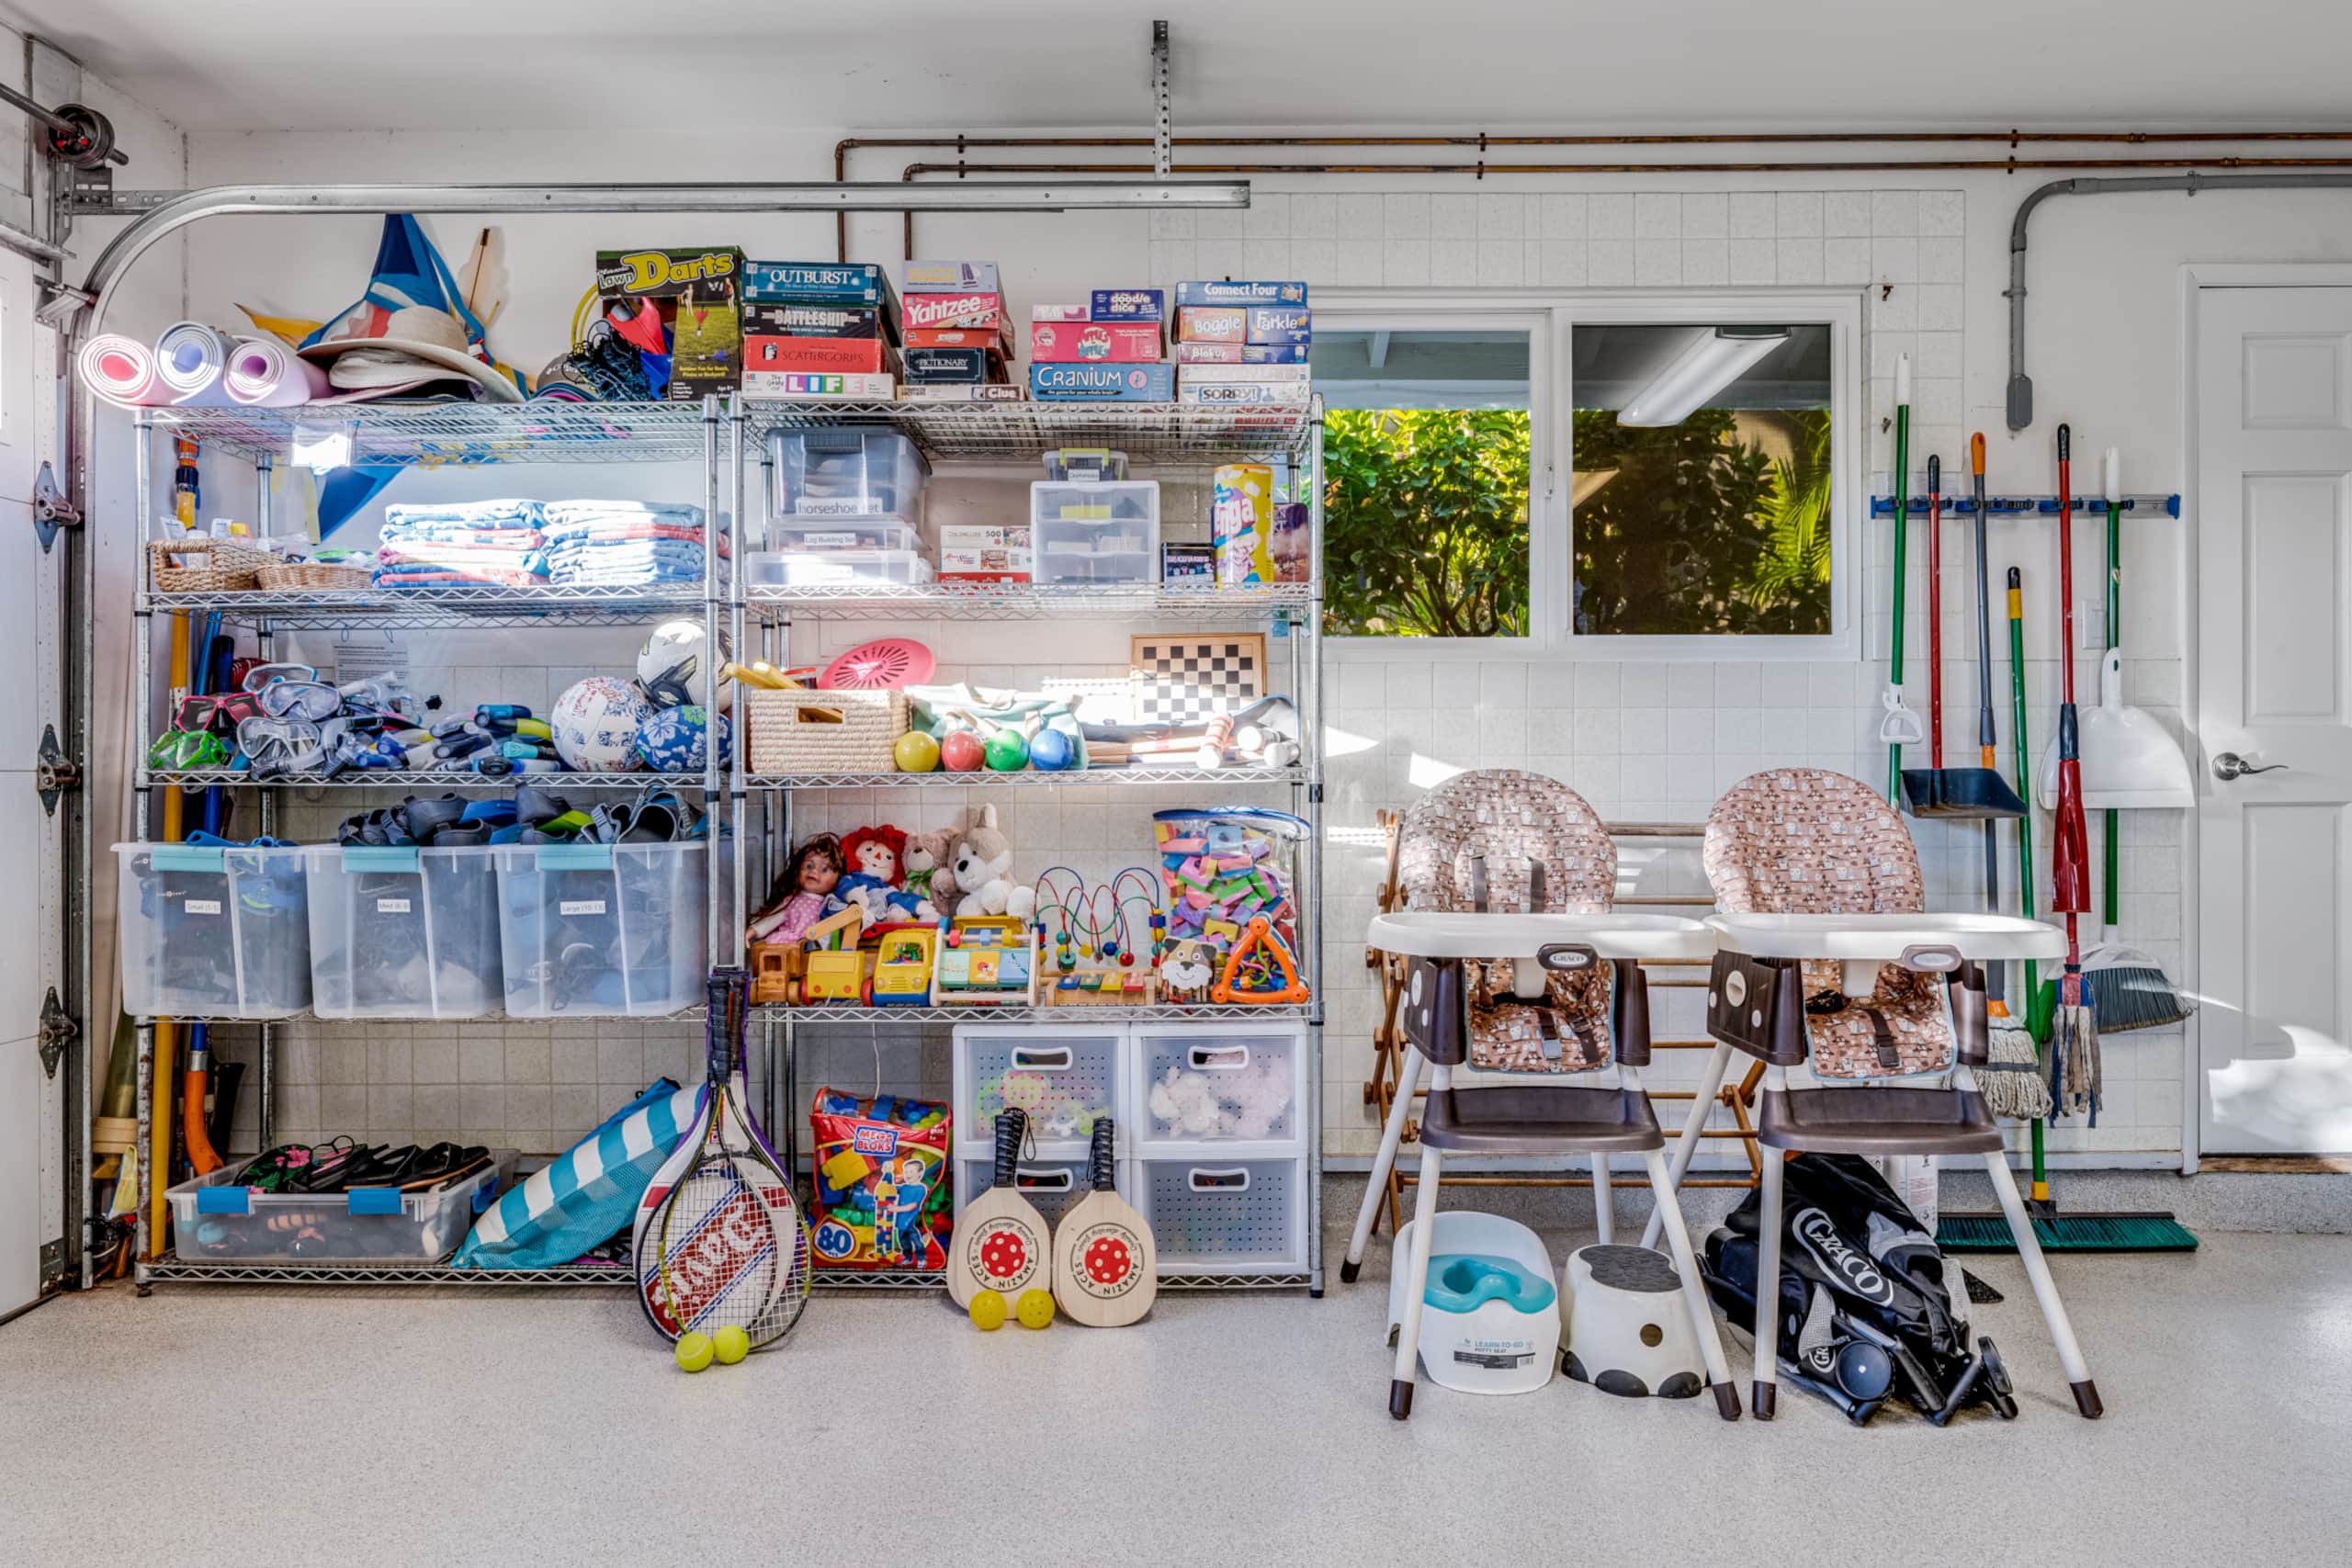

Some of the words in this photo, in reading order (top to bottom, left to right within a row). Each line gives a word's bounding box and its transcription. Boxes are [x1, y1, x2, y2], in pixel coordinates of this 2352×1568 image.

[599, 272, 635, 289] Lawn
[620, 251, 734, 291] Darts
[770, 269, 853, 285] OUTBURST
[1111, 292, 1151, 303] doodle
[1204, 283, 1250, 296] Connect
[1251, 283, 1278, 295] Four
[907, 296, 981, 325] Yahtzee
[1111, 303, 1136, 312] dice
[775, 309, 849, 327] BATTLESHIP
[1194, 315, 1241, 335] Boggle
[1257, 310, 1298, 330] Farkle
[782, 350, 864, 363] SCATTERGORIES
[919, 358, 968, 367] PICTIONARY
[787, 376, 863, 392] LIFE
[988, 388, 1016, 398] Clue
[1203, 389, 1257, 400] SORRY!
[797, 502, 858, 514] horseshoe
[1214, 497, 1255, 536] enga
[859, 1131, 893, 1142] MEGA
[857, 1140, 891, 1151] BLOKS
[818, 1225, 852, 1253] 80
[1805, 1219, 1883, 1293] GRACO
[971, 1255, 990, 1281] ACES
[1075, 1261, 1095, 1288] ACES
[1475, 1340, 1523, 1348] LEARN-TO-GO
